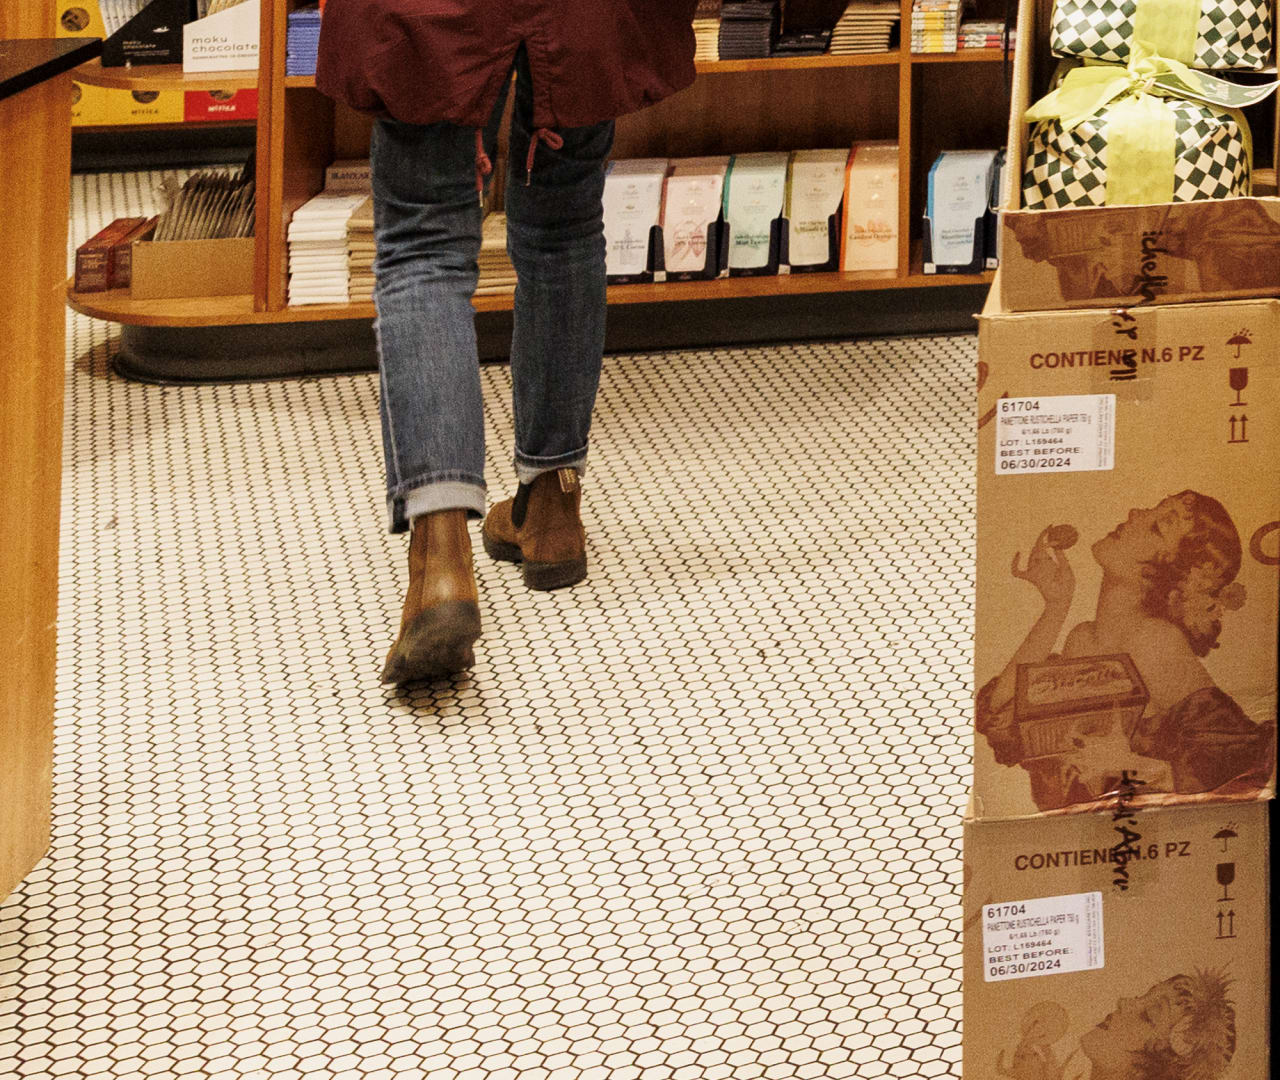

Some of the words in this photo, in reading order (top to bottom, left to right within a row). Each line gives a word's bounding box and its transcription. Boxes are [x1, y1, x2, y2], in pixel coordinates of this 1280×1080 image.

[192, 36, 228, 44] moku
[192, 43, 259, 53] chocolate
[1141, 347, 1173, 363] N.6
[1179, 345, 1206, 362] PZ
[1001, 400, 1041, 413] 61704
[1000, 449, 1031, 457] BEST
[1000, 458, 1071, 470] 06/30/2024
[1166, 841, 1191, 858] PZ
[987, 904, 1026, 919] 61704
[989, 954, 1020, 964] BEST
[1022, 947, 1073, 960] BEFORE:
[990, 959, 1061, 977] 06/30/2024
